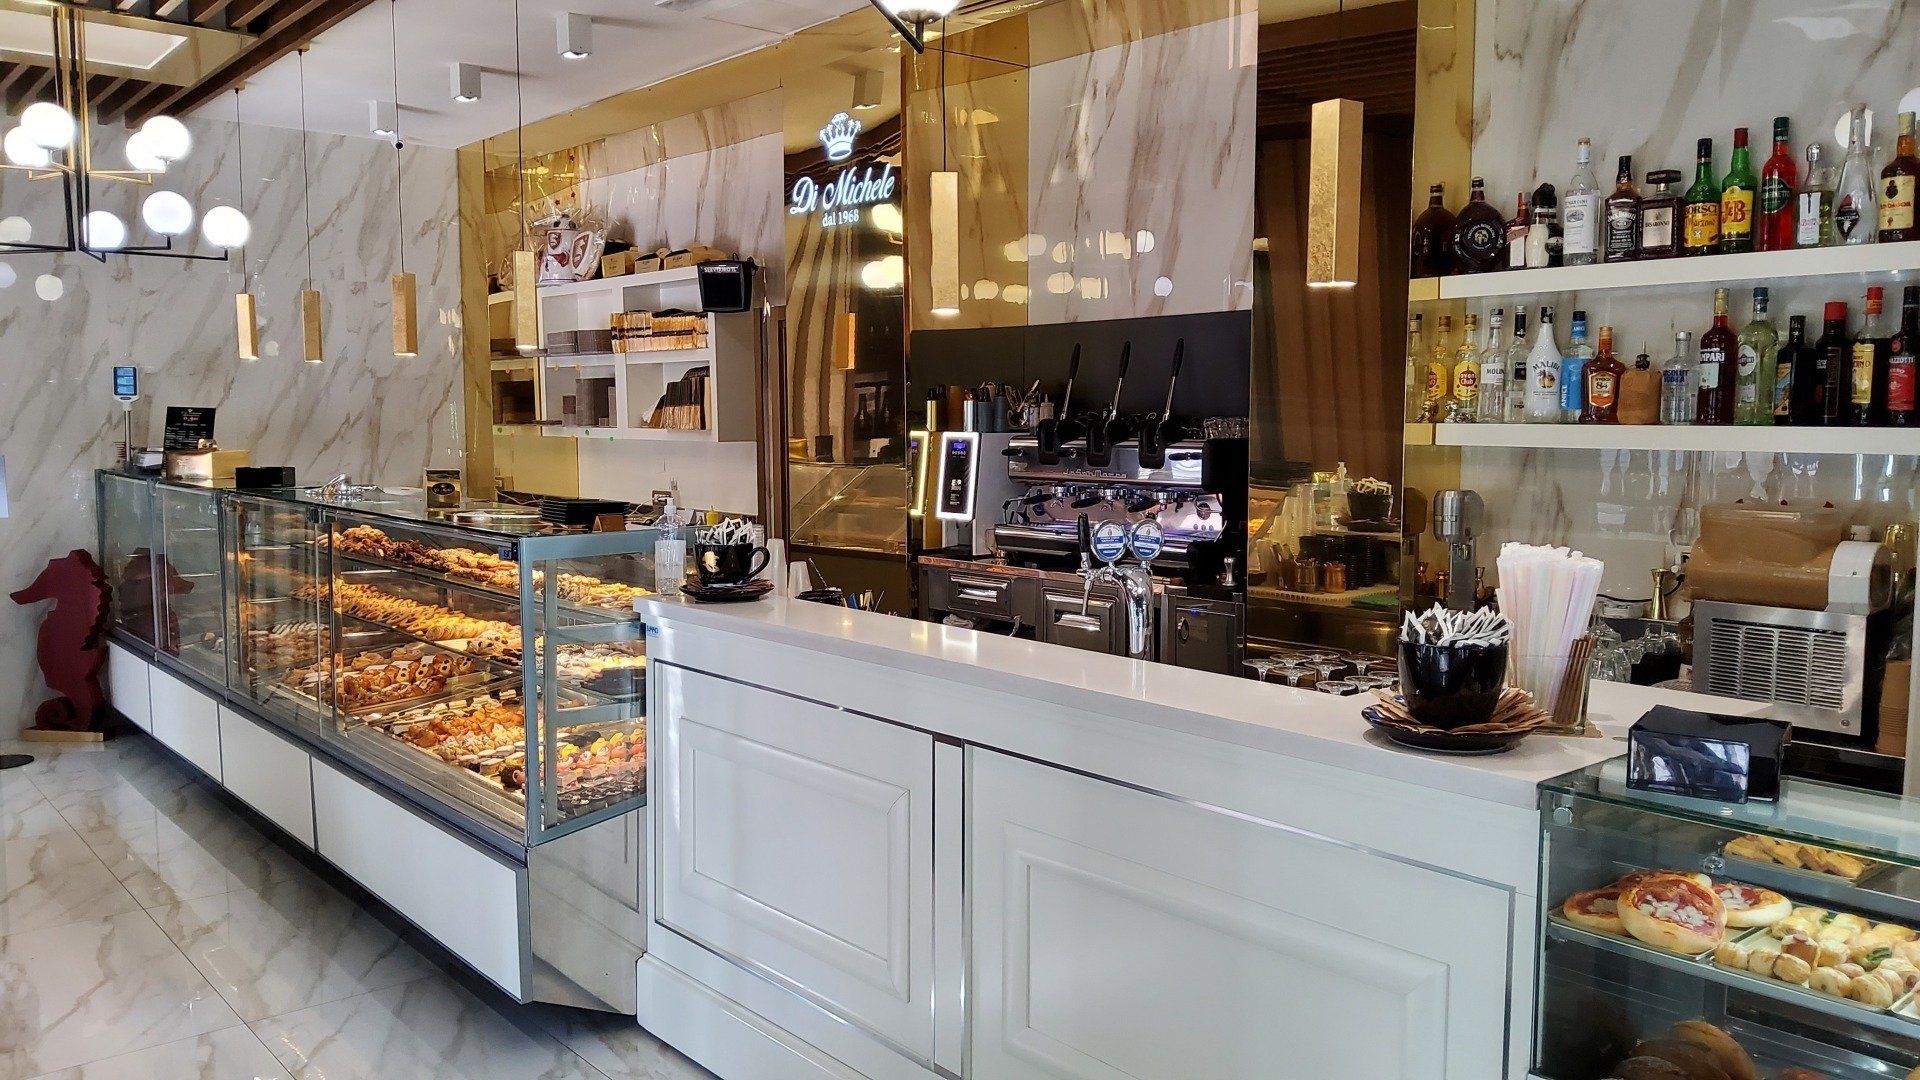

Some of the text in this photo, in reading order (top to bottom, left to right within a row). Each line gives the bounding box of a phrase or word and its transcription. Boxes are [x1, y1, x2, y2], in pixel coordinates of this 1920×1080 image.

[790, 163, 895, 215] Di Michele
[822, 208, 859, 227] dal 1968
